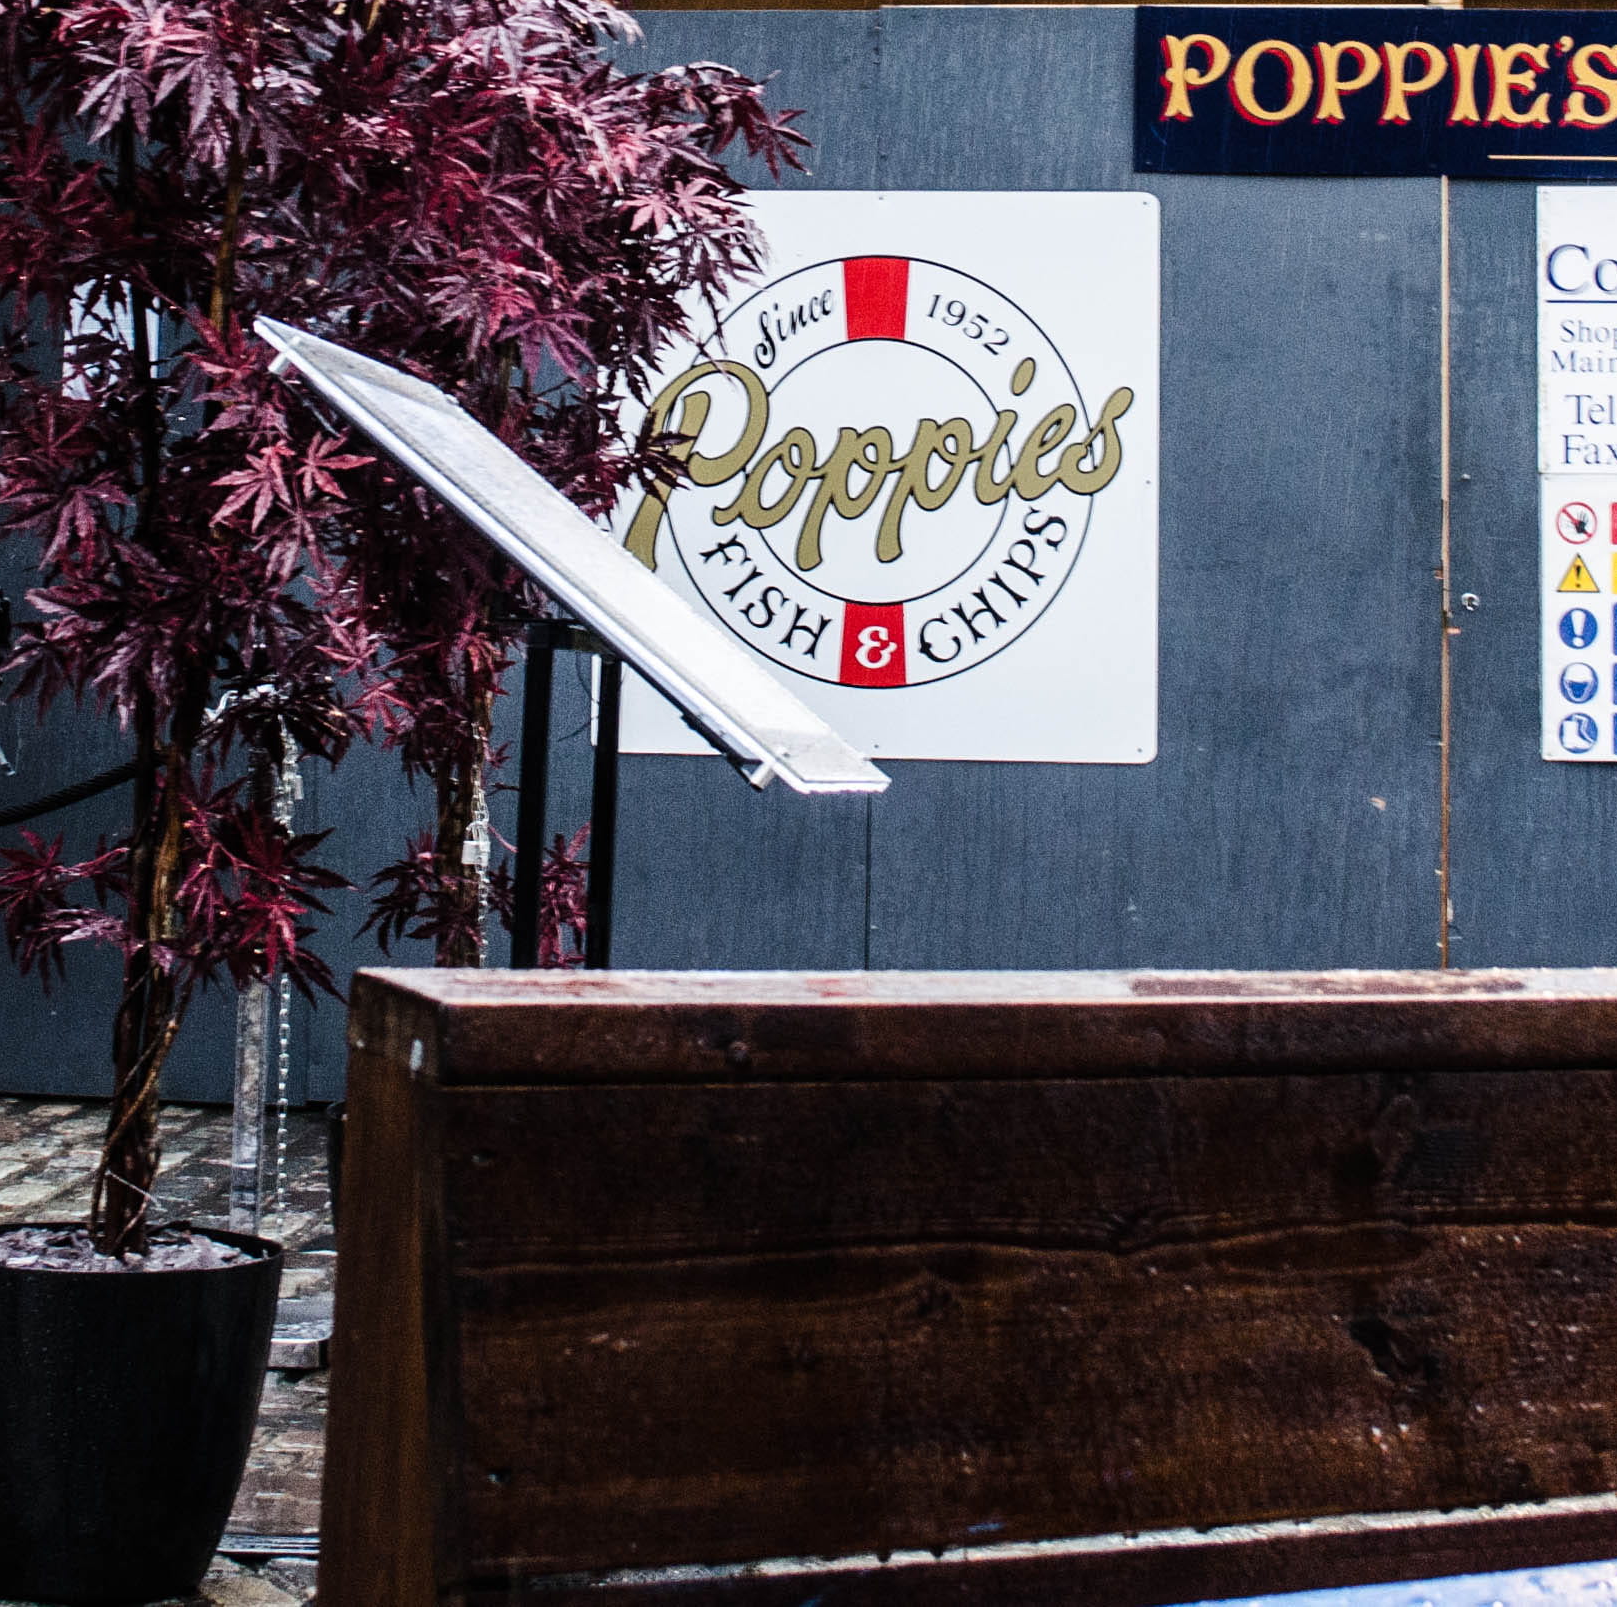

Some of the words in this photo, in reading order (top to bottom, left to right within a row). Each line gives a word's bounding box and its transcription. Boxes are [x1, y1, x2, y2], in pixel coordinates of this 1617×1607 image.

[753, 288, 834, 370] Since
[924, 293, 1011, 356] 1952
[622, 356, 1135, 573] Poppies
[698, 534, 832, 660] FISH
[855, 625, 898, 669] &
[918, 505, 1068, 664] CHIPS
